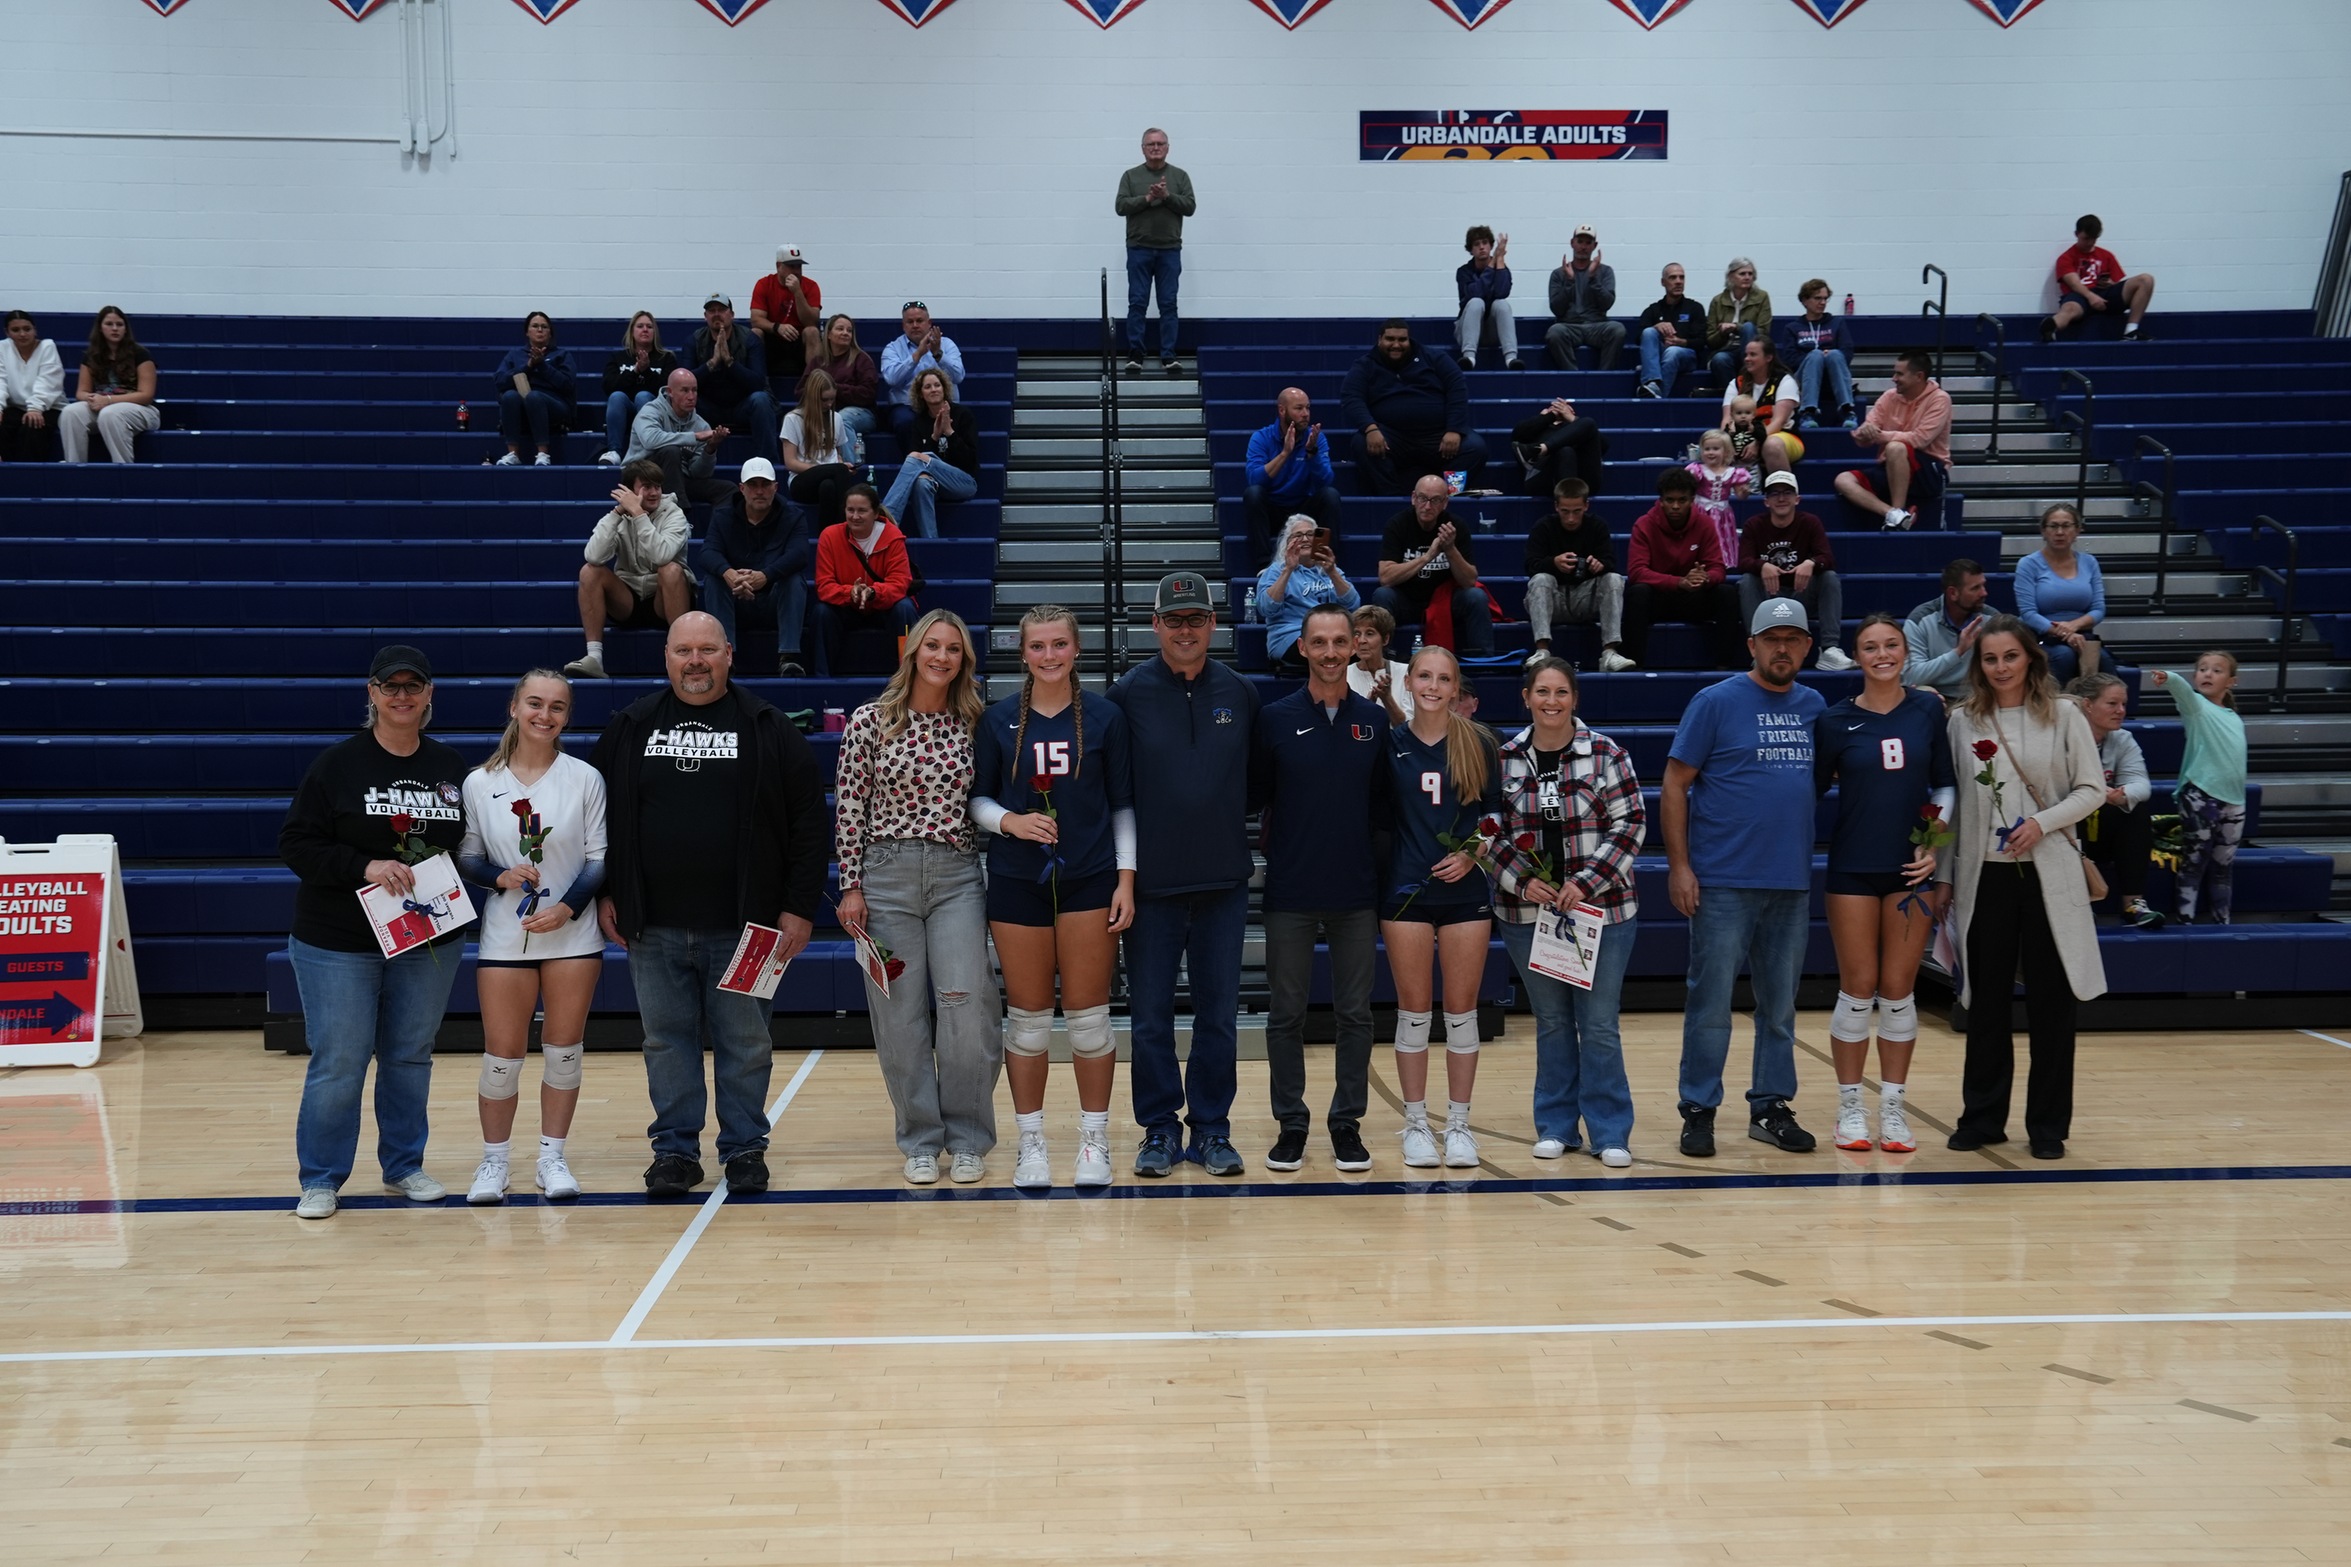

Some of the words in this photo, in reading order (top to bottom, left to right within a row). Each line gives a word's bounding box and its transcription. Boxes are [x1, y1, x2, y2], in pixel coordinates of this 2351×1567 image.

[1402, 126, 1537, 144] URBANDALE
[1541, 126, 1626, 144] ADULTS
[790, 249, 800, 257] U
[1173, 580, 1195, 592] U
[675, 721, 713, 731] URBANDALE
[1351, 724, 1374, 741] U
[647, 729, 738, 748] J-HAWKS
[1757, 730, 1809, 743] FRIENDS
[647, 746, 735, 757] VOLLEYBALL
[1033, 741, 1069, 775] 15
[1881, 738, 1904, 770] 8
[676, 757, 700, 772] U
[1421, 771, 1441, 805] 9
[364, 787, 452, 808] J-HAWK
[370, 804, 458, 819] VOLLEYBALL
[0, 881, 88, 897] LEYBALL
[0, 898, 67, 914] EATING
[7, 961, 64, 973] GUESTS
